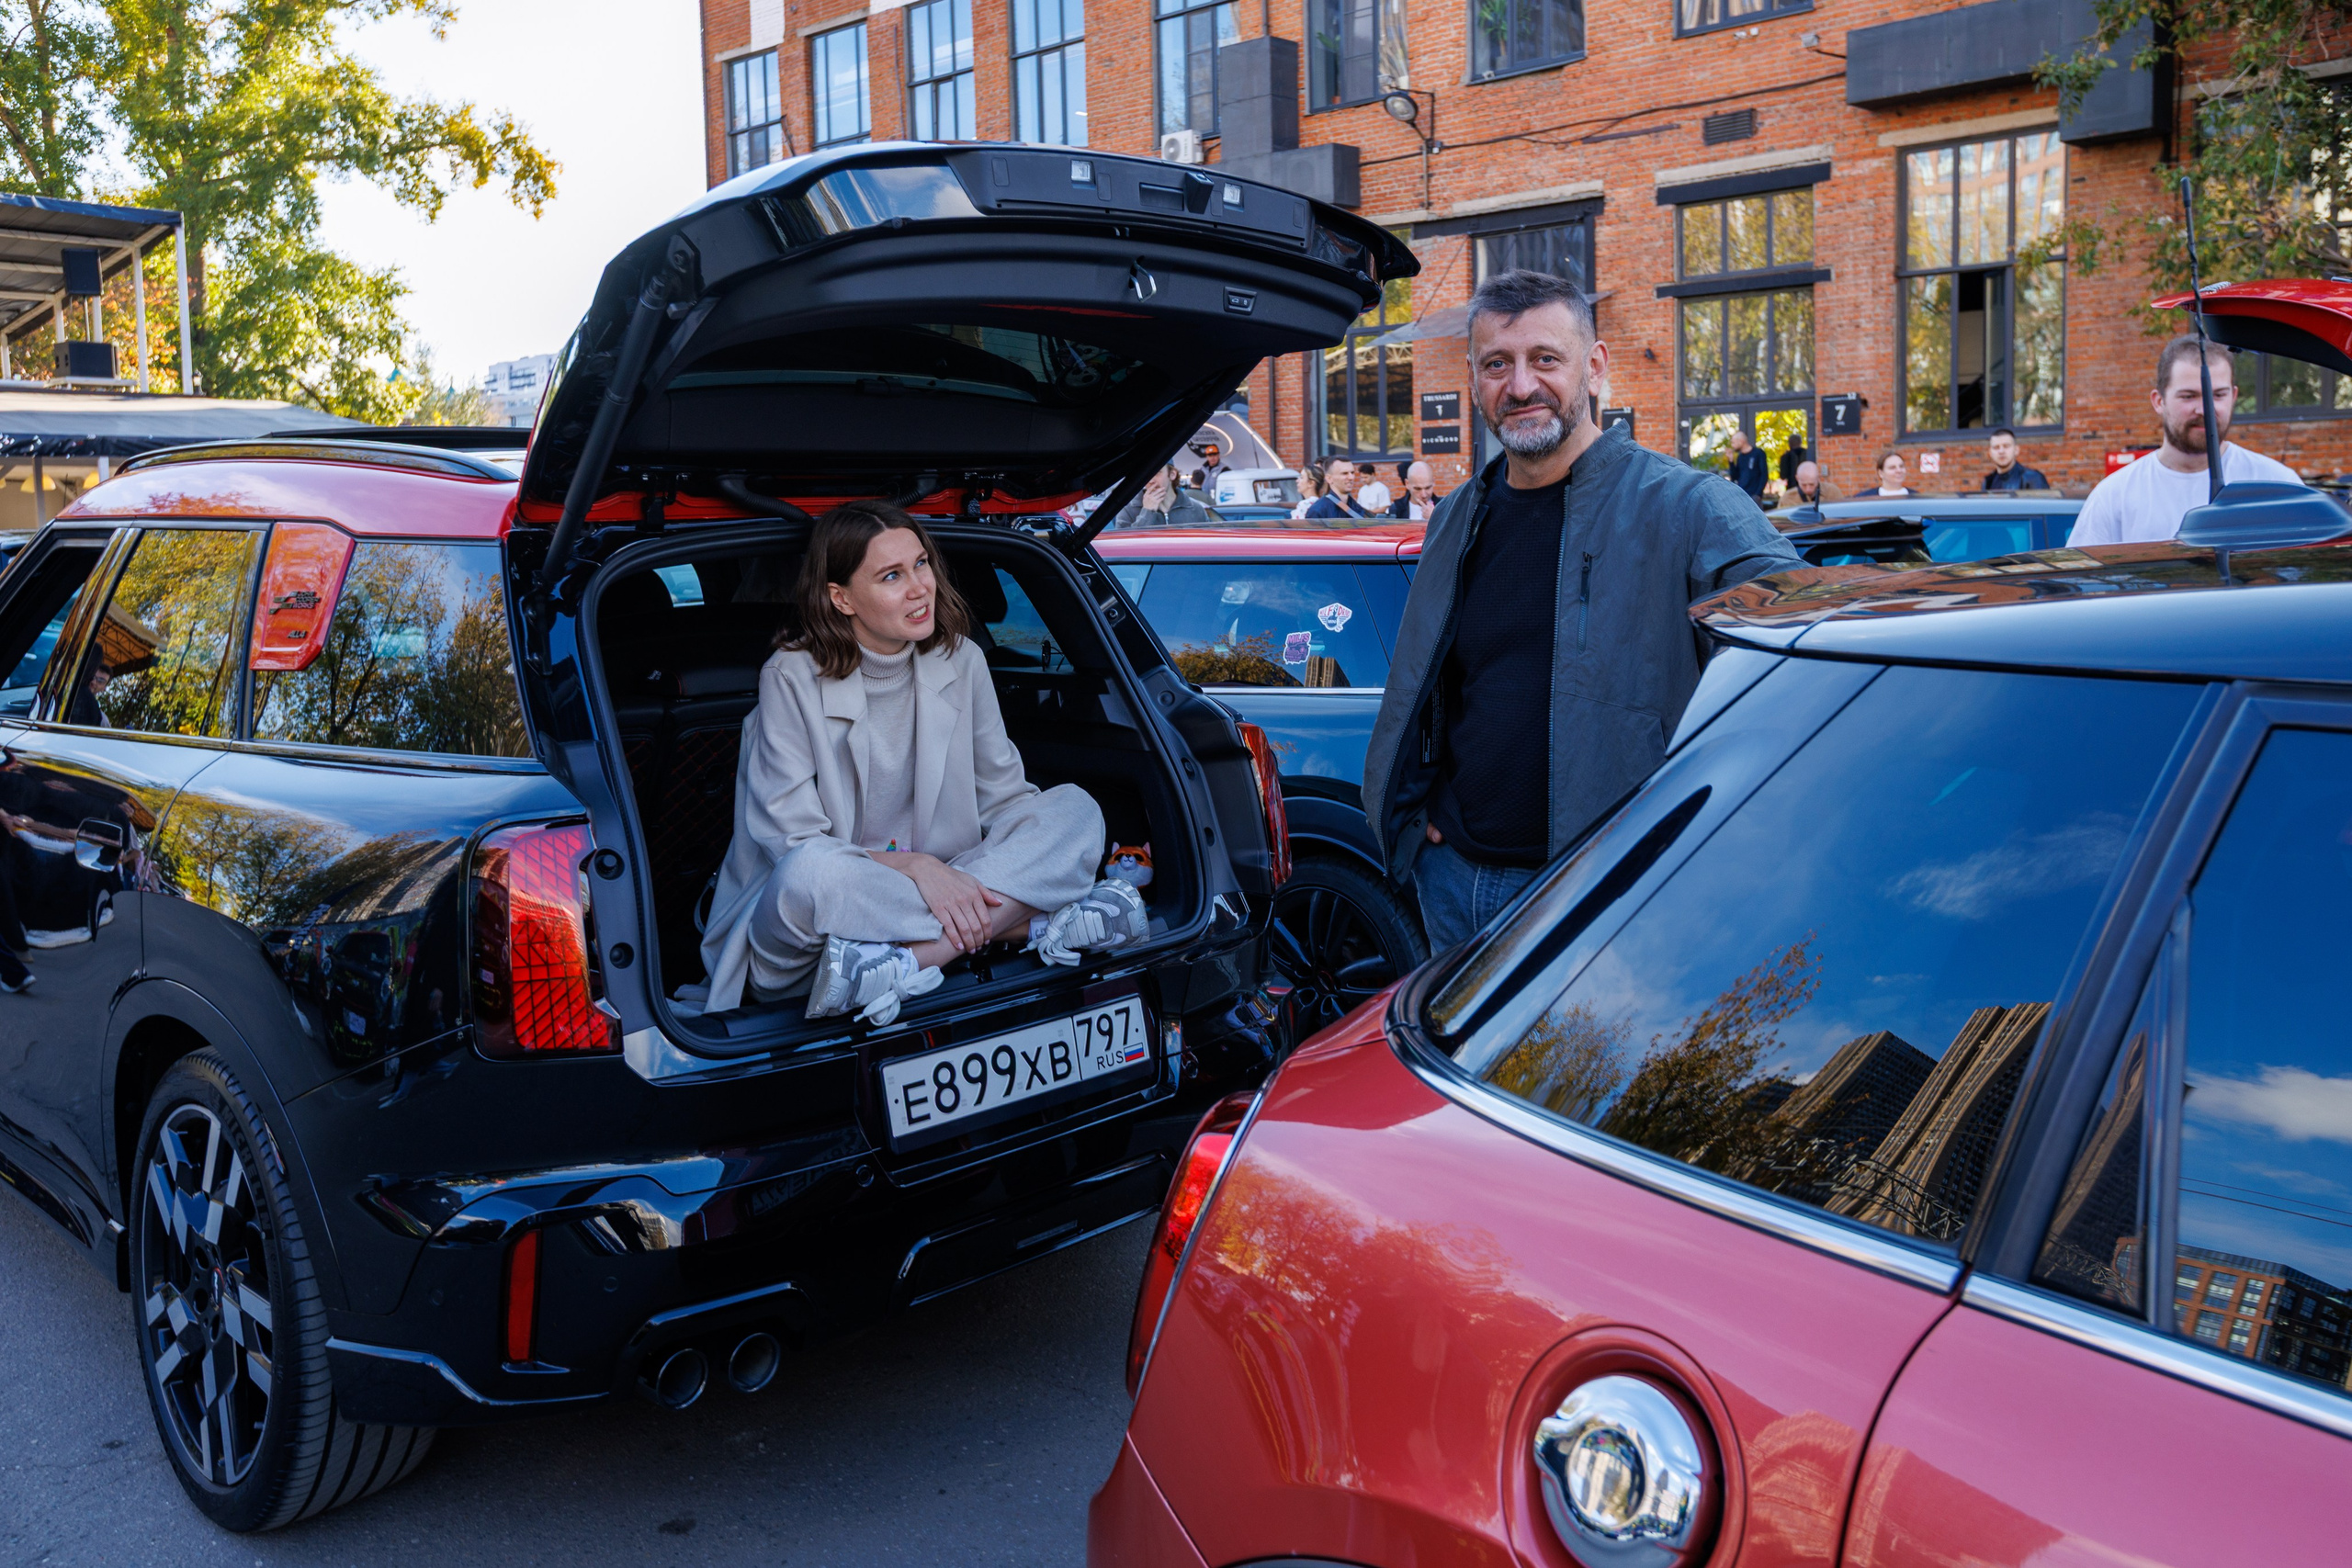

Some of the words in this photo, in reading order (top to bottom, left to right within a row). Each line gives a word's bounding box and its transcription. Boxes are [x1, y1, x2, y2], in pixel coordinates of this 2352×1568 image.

[1835, 404, 1847, 421] 7
[288, 630, 308, 638] ALL4
[1287, 633, 1310, 644] MILFS
[1077, 1006, 1131, 1057] 797
[1097, 1050, 1125, 1071] RUS
[221, 1106, 271, 1231] MICHELIN
